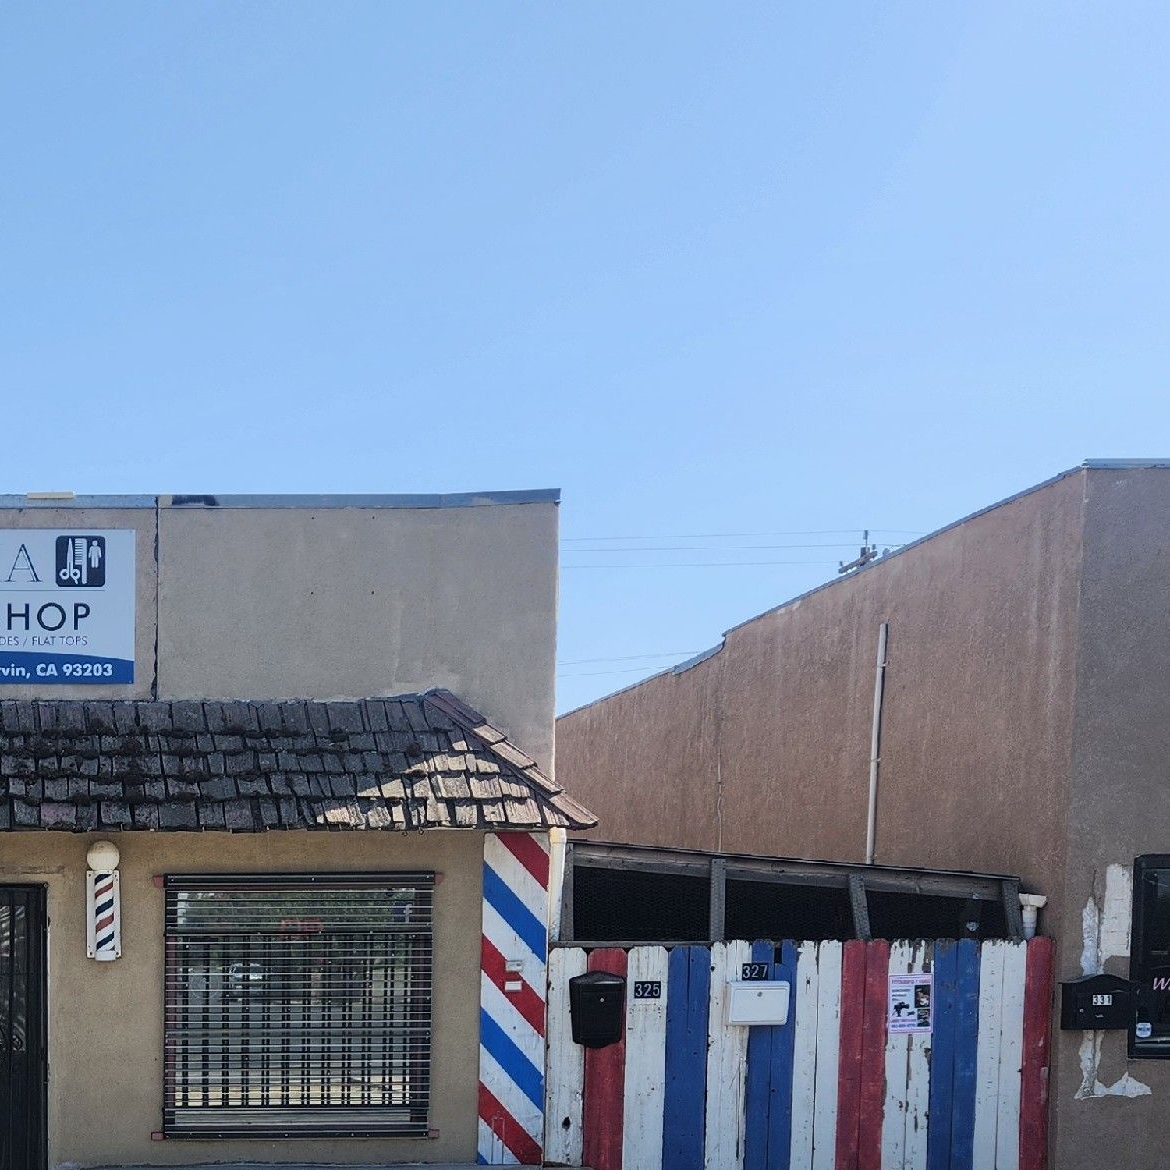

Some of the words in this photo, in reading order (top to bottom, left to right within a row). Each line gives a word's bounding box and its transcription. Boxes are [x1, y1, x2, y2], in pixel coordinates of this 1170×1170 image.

[32, 636, 56, 646] FLAT
[58, 636, 88, 646] TOPS
[36, 663, 58, 677] CA
[62, 663, 113, 677] 93203
[742, 965, 768, 978] 327
[635, 983, 660, 997] 325
[1093, 995, 1112, 1005] 331
